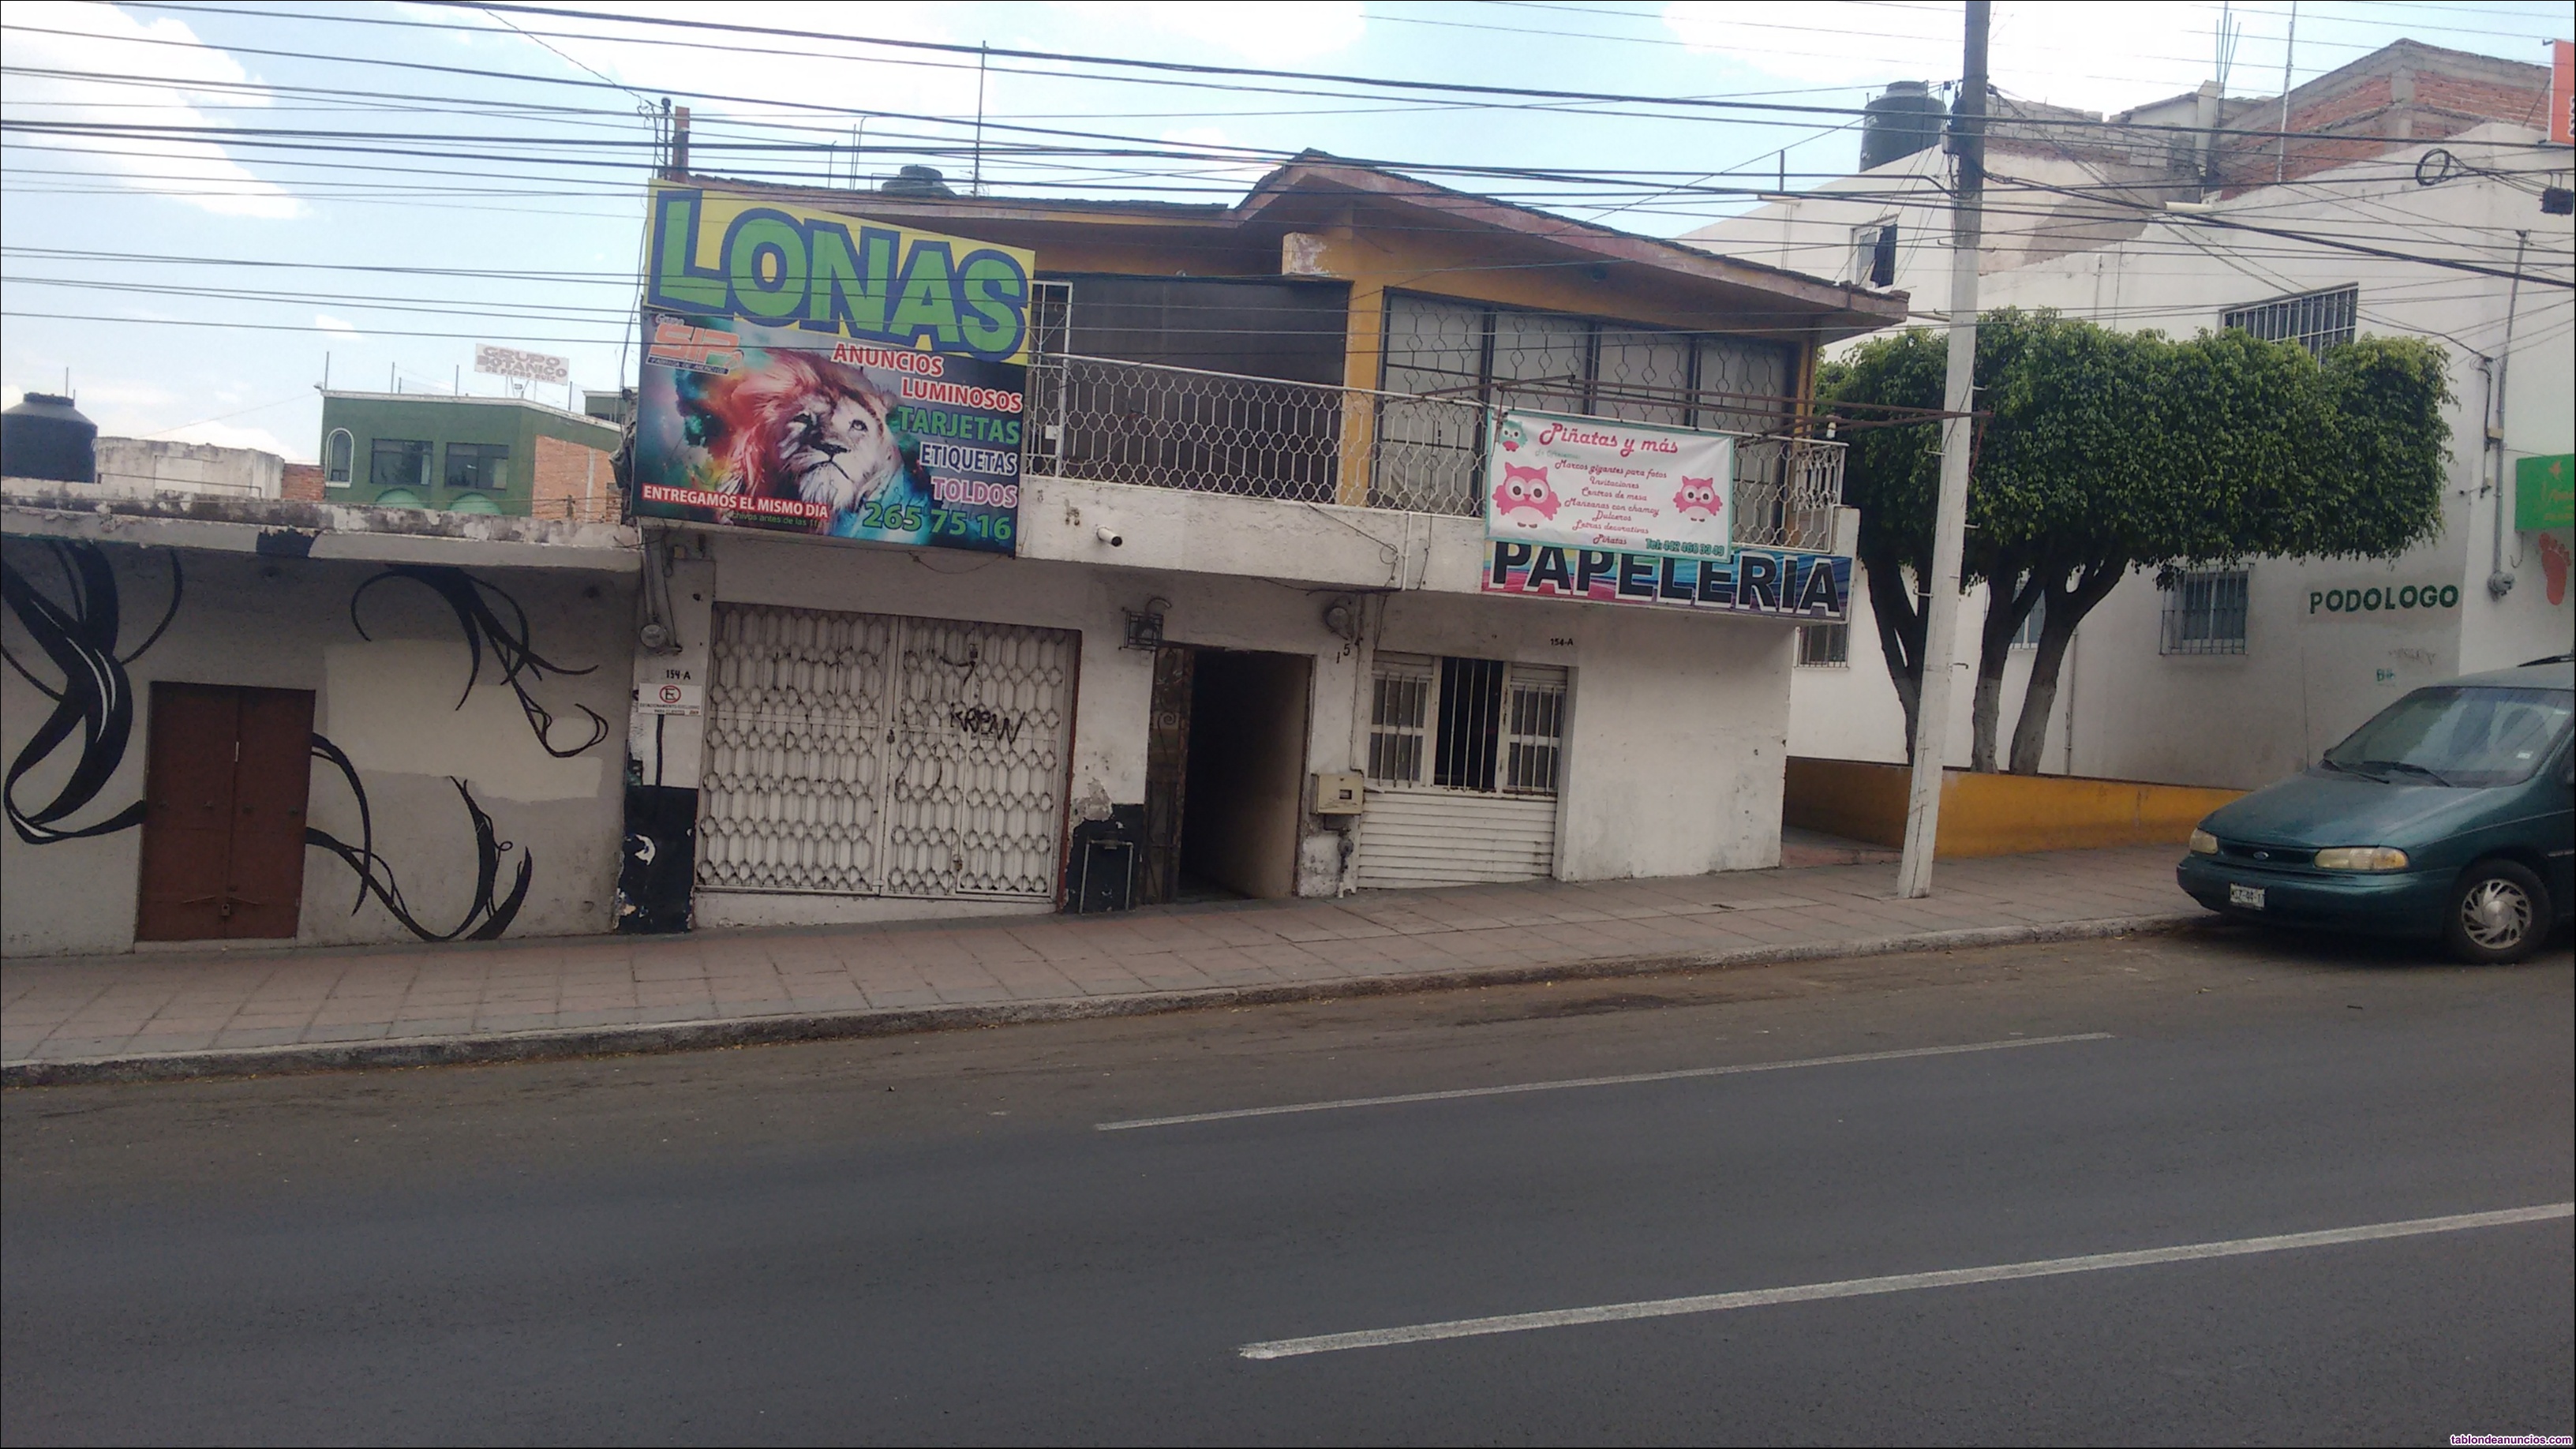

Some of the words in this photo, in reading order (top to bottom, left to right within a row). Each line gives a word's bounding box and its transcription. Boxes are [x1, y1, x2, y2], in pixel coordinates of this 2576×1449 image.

[647, 190, 1028, 362] LONAS
[483, 346, 560, 367] GRUPO
[832, 342, 944, 376] ANUNCIOS
[901, 378, 1023, 413] LUMINOSOS
[898, 406, 1020, 444] TARJETAS
[1539, 422, 1618, 445] Piñatas
[1620, 438, 1634, 457] y
[1641, 438, 1679, 454] más
[920, 442, 1017, 475] ETIQUETAS
[1555, 459, 1588, 470] Marcos
[1589, 465, 1623, 476] gigantes
[1625, 469, 1645, 478] para
[1646, 468, 1667, 480] fotos
[931, 476, 1018, 507] TOLDOS
[1582, 487, 1612, 498] Centros
[1615, 490, 1624, 499] de
[1589, 476, 1639, 489] Invitaciones
[643, 485, 737, 509] ENTREGAMOS
[739, 499, 754, 511] EL
[758, 499, 803, 515] MISMO
[805, 504, 829, 518] DIA
[1564, 497, 1610, 509] Manzanas
[1628, 504, 1660, 518] chamoy
[1592, 510, 1631, 522] Dulceros
[759, 515, 781, 524] antes
[783, 516, 794, 525] de
[863, 501, 922, 532] 265
[930, 509, 968, 535] 75
[976, 514, 1012, 540] 16
[1604, 522, 1649, 534] decorativas
[1489, 541, 1842, 616] PAPELERIA
[2309, 585, 2459, 614] PODOLOGO
